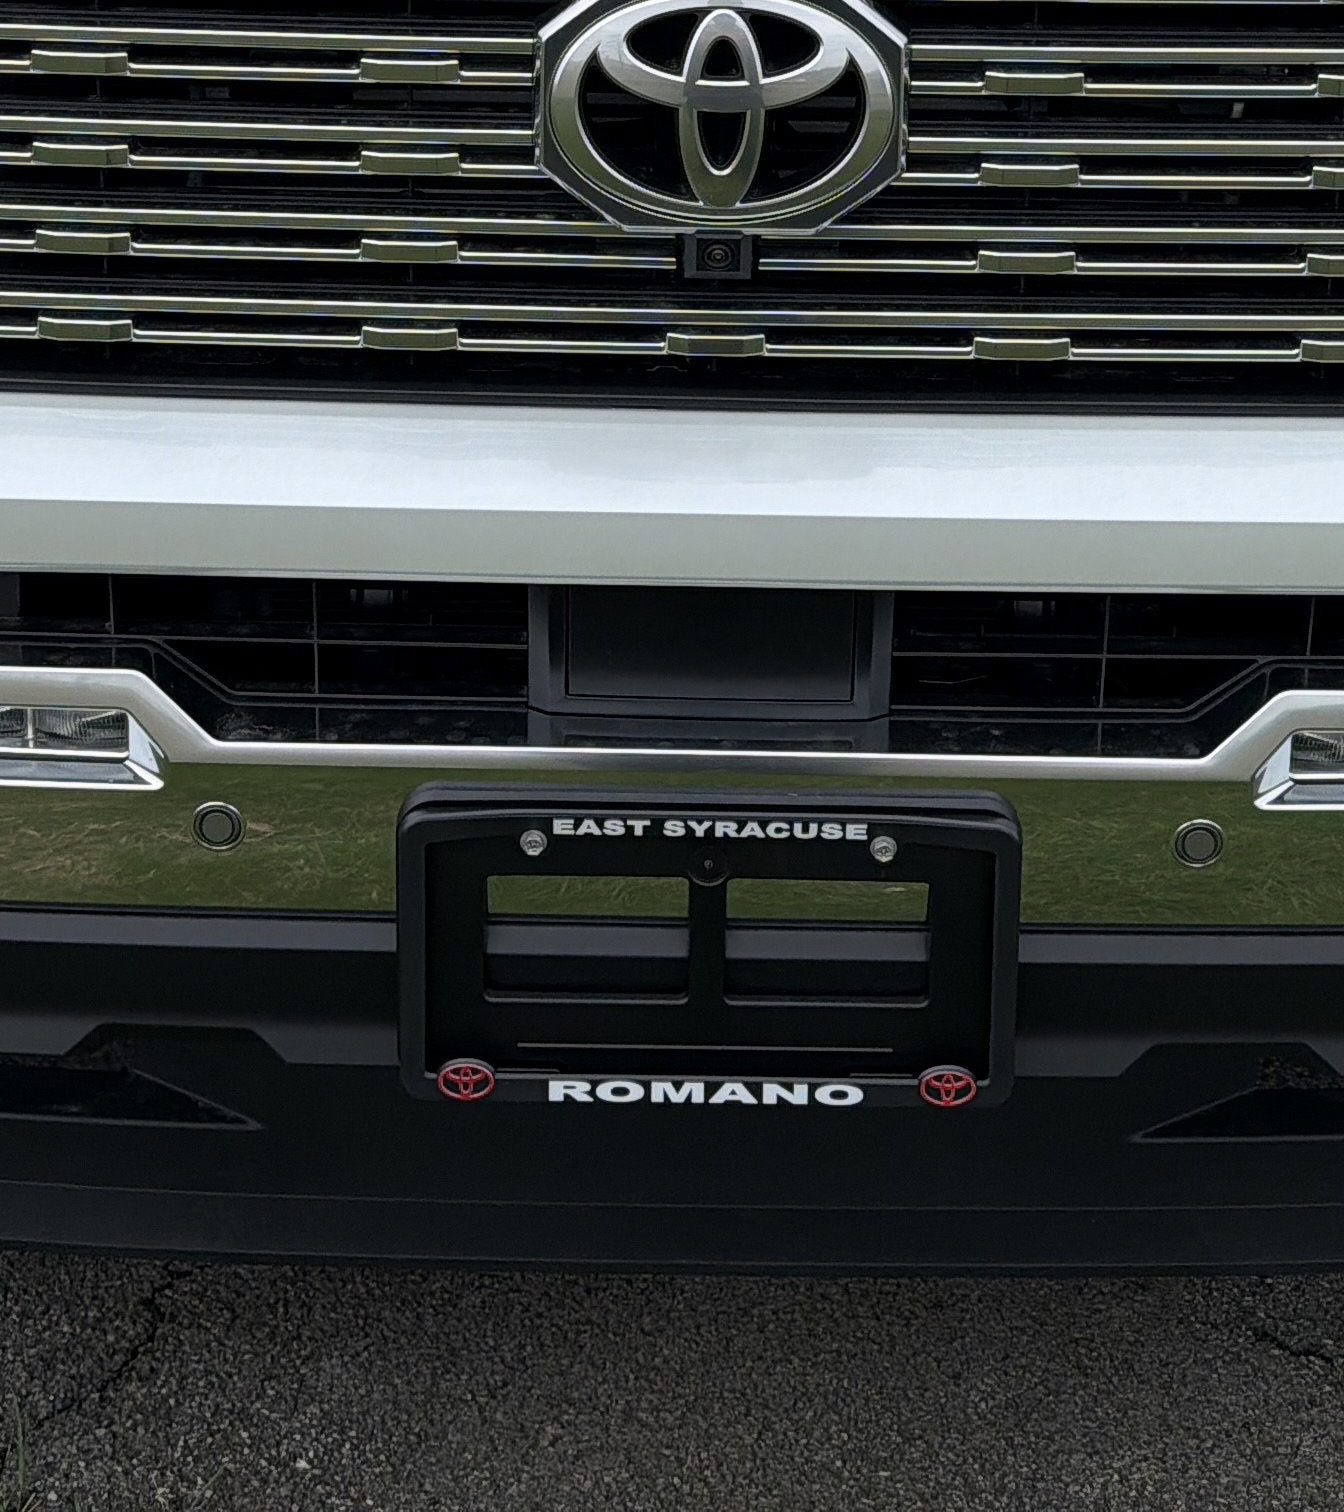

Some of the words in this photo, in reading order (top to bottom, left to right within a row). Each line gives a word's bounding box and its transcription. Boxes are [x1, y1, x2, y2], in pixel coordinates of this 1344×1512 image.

[552, 817, 651, 836] EAST
[662, 818, 869, 841] SYRACUSE
[547, 1080, 864, 1106] ROMANO
